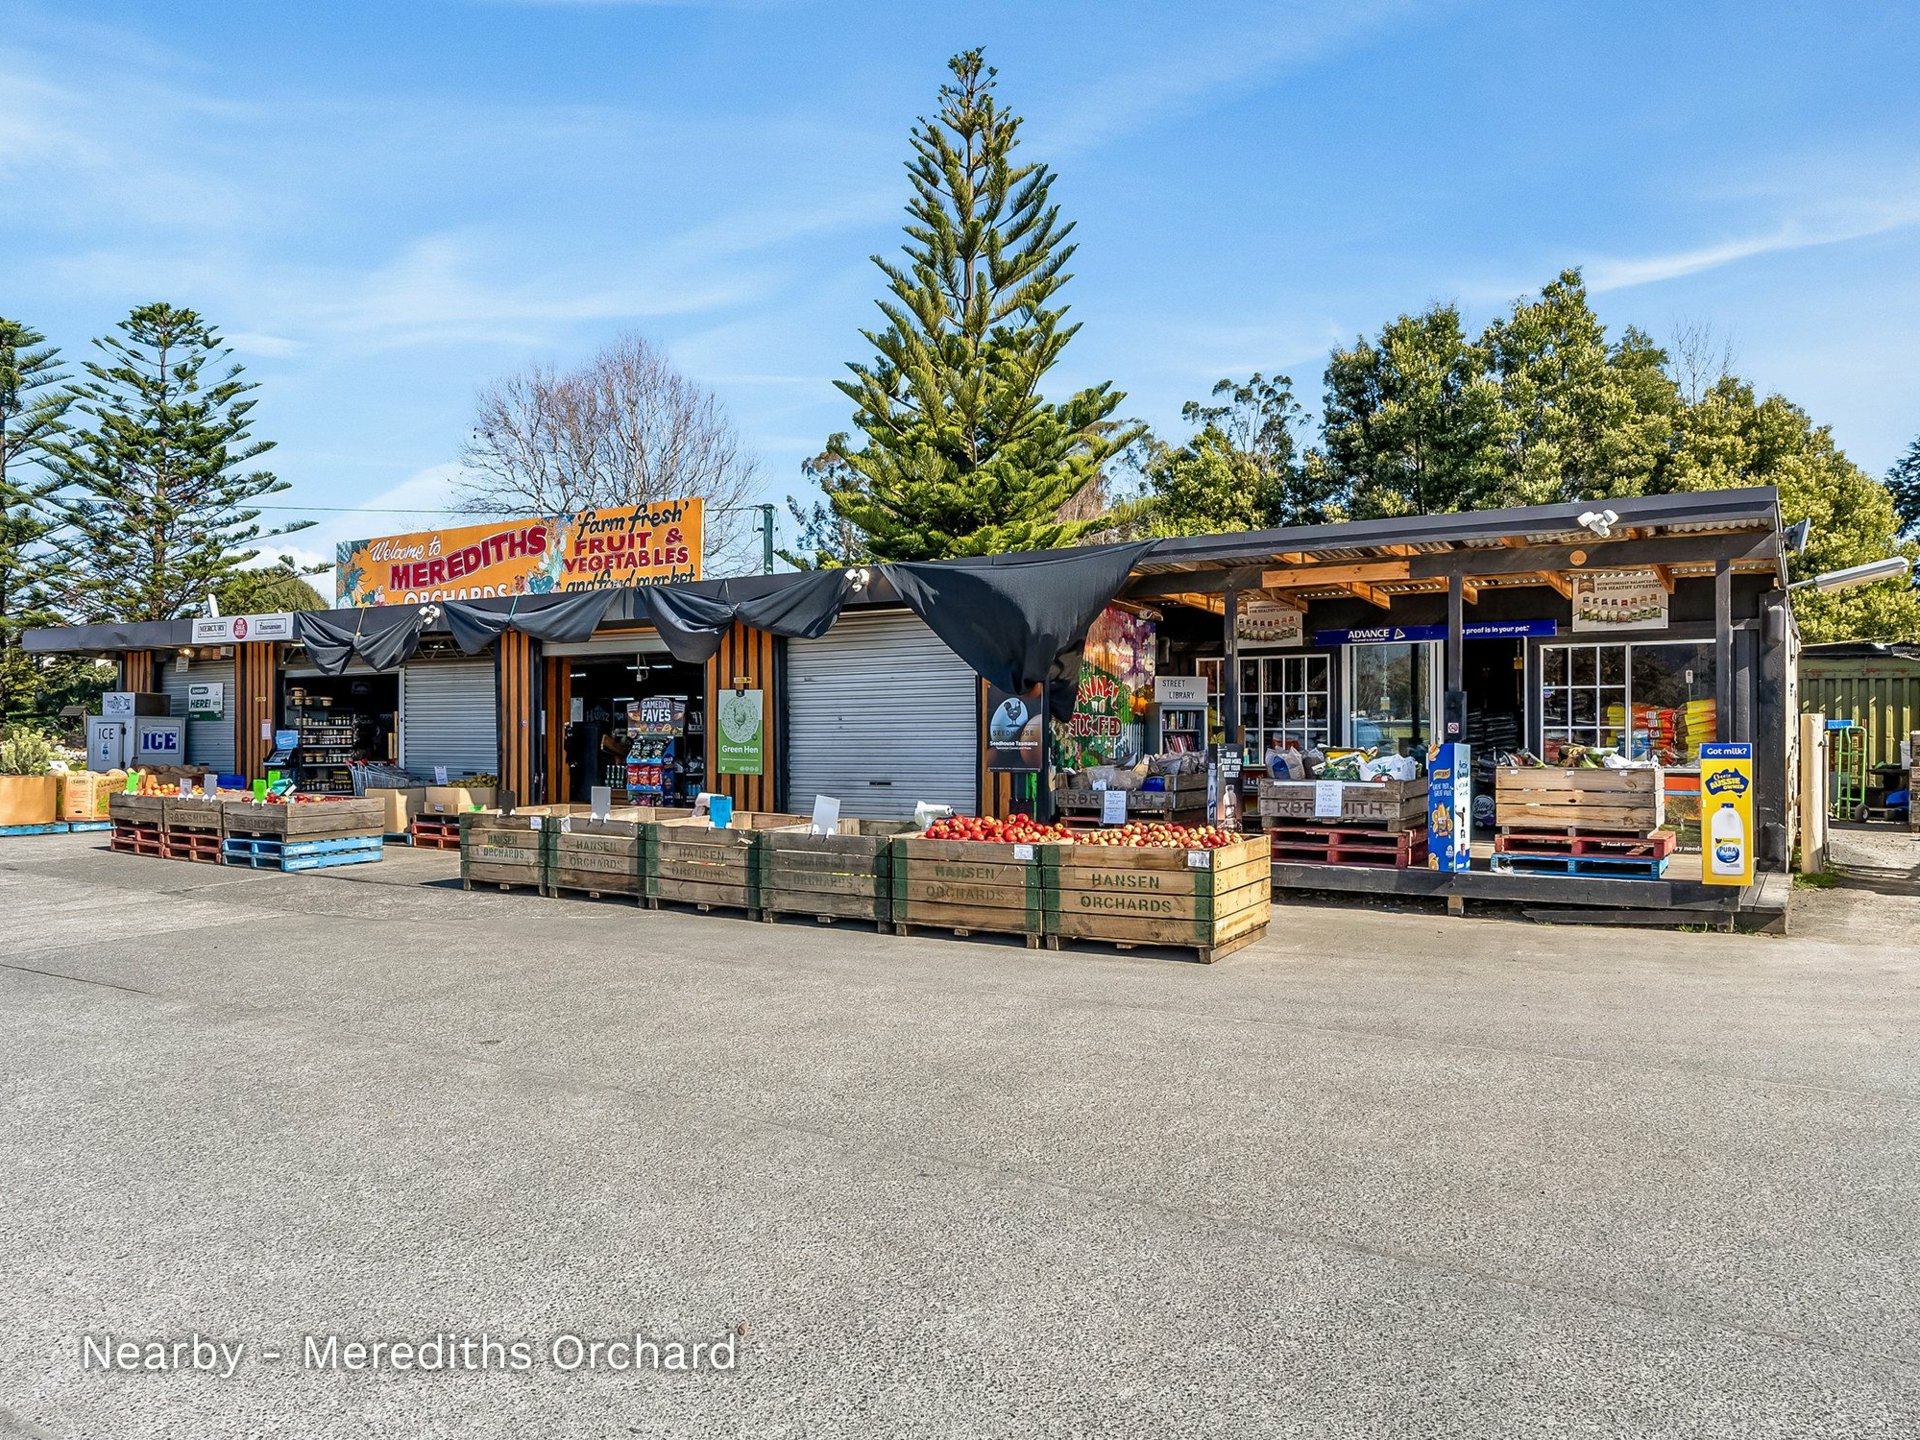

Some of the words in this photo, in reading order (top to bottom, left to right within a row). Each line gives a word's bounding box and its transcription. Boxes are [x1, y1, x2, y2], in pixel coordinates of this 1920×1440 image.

[573, 532, 652, 556] FRUIT
[665, 527, 683, 545] &
[369, 540, 425, 562] Welcome
[428, 536, 442, 556] to
[388, 525, 549, 591] MEREDITHS
[563, 546, 689, 573] VEGETABLES
[637, 564, 696, 586] market
[1348, 629, 1390, 639] ADVANCE
[1466, 626, 1484, 635] proof
[1499, 626, 1514, 634] your
[1162, 680, 1185, 688] STREET
[1168, 691, 1196, 700] LIBRARY
[190, 699, 212, 709] HERE!
[641, 700, 671, 709] GAMEDAY
[641, 709, 672, 722] FAVES
[98, 727, 115, 740] ICE
[142, 730, 177, 750] ICE
[721, 744, 743, 754] Green
[744, 745, 759, 754] Hen
[1706, 747, 1723, 755] Got
[1723, 747, 1748, 755] milk?
[487, 833, 518, 845] HANSEN
[576, 840, 617, 852] HANSEN
[483, 848, 525, 860] ORCHARDS
[678, 848, 725, 861] HANSEN
[569, 857, 623, 869] ORCHARDS
[935, 864, 995, 880] HANSEN
[1092, 873, 1160, 890] HANSEN
[926, 886, 1005, 901] ORCHARDS
[1080, 896, 1172, 913] ORCHARDS
